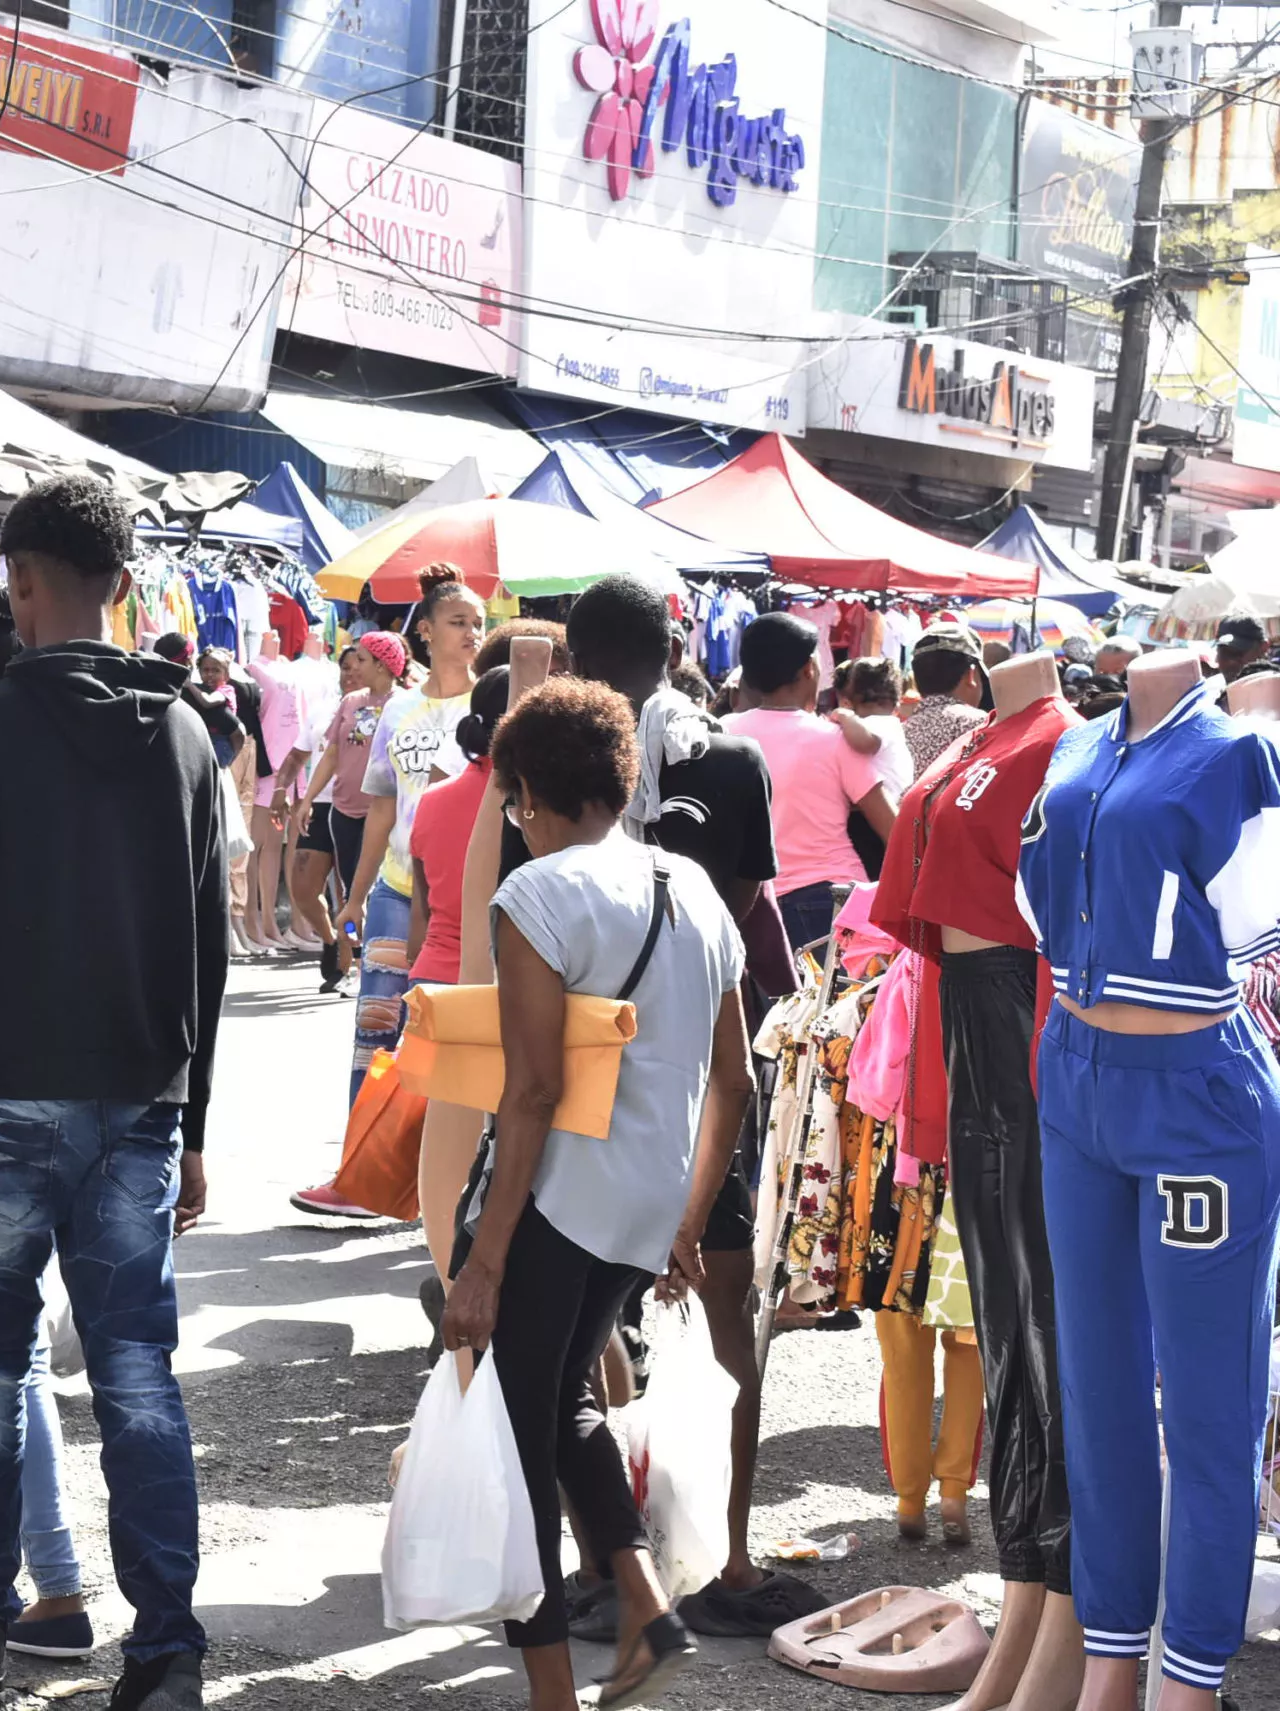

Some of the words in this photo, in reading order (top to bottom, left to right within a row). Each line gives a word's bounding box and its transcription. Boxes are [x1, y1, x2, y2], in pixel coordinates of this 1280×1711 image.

[347, 156, 449, 218] CALZADO
[327, 204, 466, 282] CARMONTERO
[372, 290, 454, 331] 809-466-7023
[1157, 1173, 1229, 1249] D
